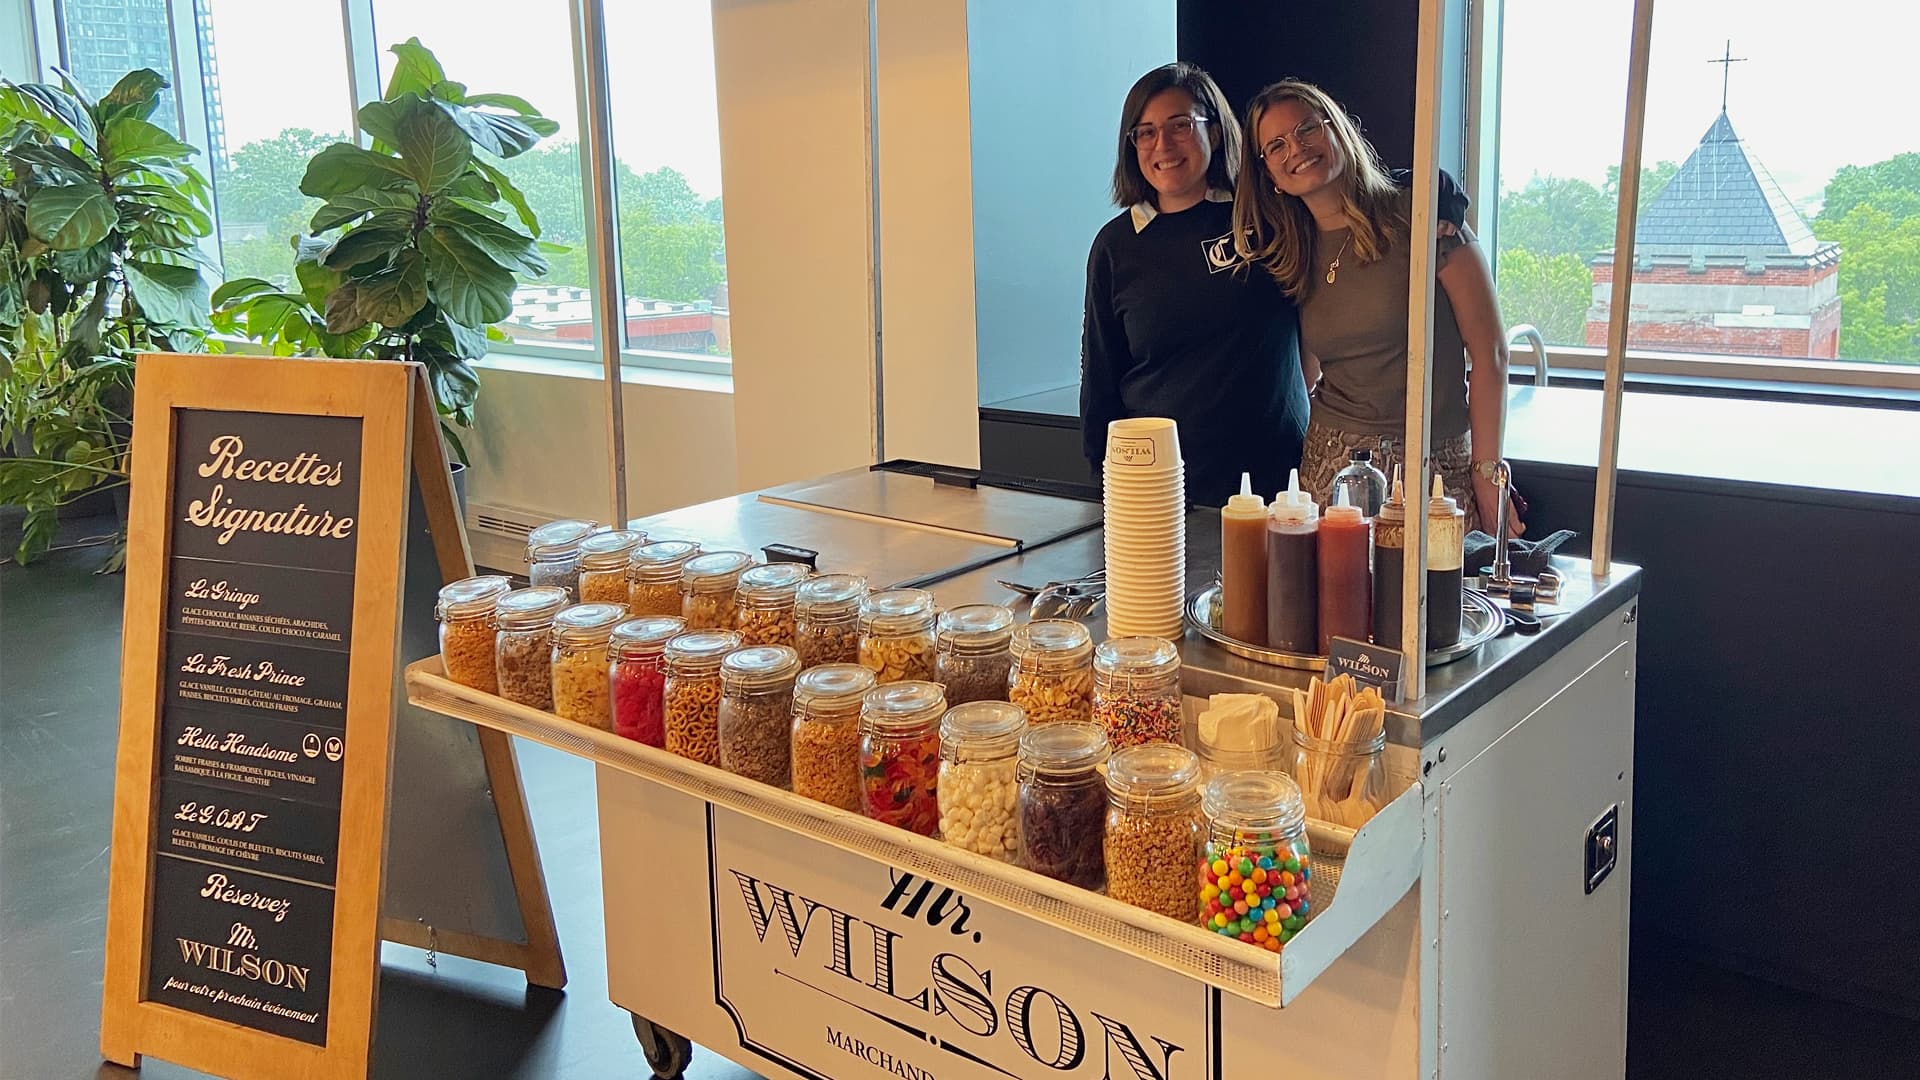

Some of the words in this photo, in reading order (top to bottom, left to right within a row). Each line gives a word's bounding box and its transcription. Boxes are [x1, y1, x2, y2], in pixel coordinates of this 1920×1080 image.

[198, 435, 343, 487] Recettes
[184, 483, 354, 545] Signature
[184, 578, 210, 599] La
[211, 580, 260, 611] Gringo
[181, 653, 207, 674] La
[207, 655, 252, 680] Fresh
[253, 661, 306, 687] Prince
[1336, 656, 1390, 679] WILSON
[177, 726, 220, 750] Hello
[219, 732, 298, 763] Handsome
[174, 801, 198, 822] Le
[200, 873, 291, 922] Réservez
[880, 866, 983, 944] Mr.
[226, 922, 259, 951] Mr.
[175, 937, 310, 993] WILSON
[728, 868, 1185, 1080] WILSON
[162, 975, 190, 991] pour
[189, 983, 216, 999] votre
[213, 989, 261, 1010] prochain
[262, 1000, 320, 1024] événement
